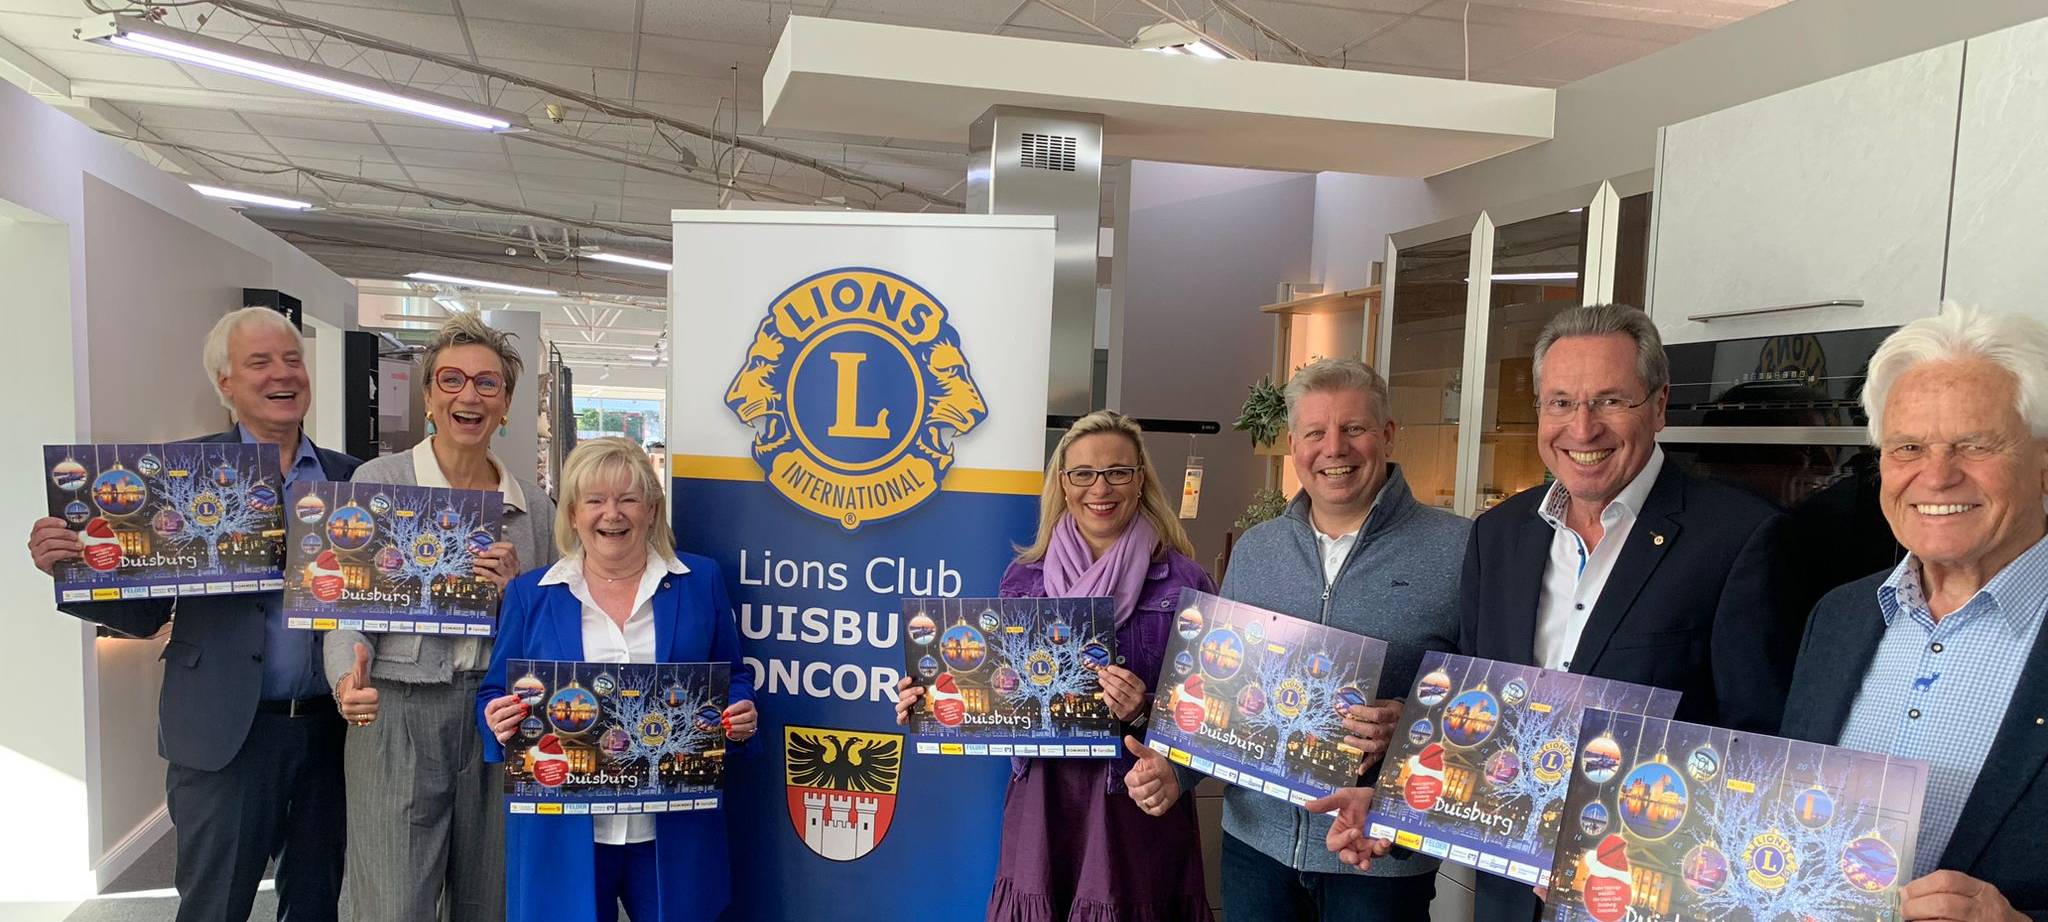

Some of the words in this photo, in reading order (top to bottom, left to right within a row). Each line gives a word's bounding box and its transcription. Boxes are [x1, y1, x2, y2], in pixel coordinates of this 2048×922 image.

[783, 278, 933, 336] LIONS
[827, 352, 890, 439] L
[781, 461, 926, 510] INTERNATIONAL
[119, 552, 197, 569] Duisburg
[739, 549, 848, 591] Lions
[865, 556, 962, 598] Club
[340, 586, 410, 607] Duisburg
[731, 603, 899, 649] UISBU
[742, 656, 901, 703] ONCOR
[962, 710, 1031, 729] Duisburg
[1199, 721, 1264, 760] Duisburg
[565, 770, 638, 788] Duisburg
[1434, 795, 1513, 836] Duisburg
[1762, 850, 1777, 872] L
